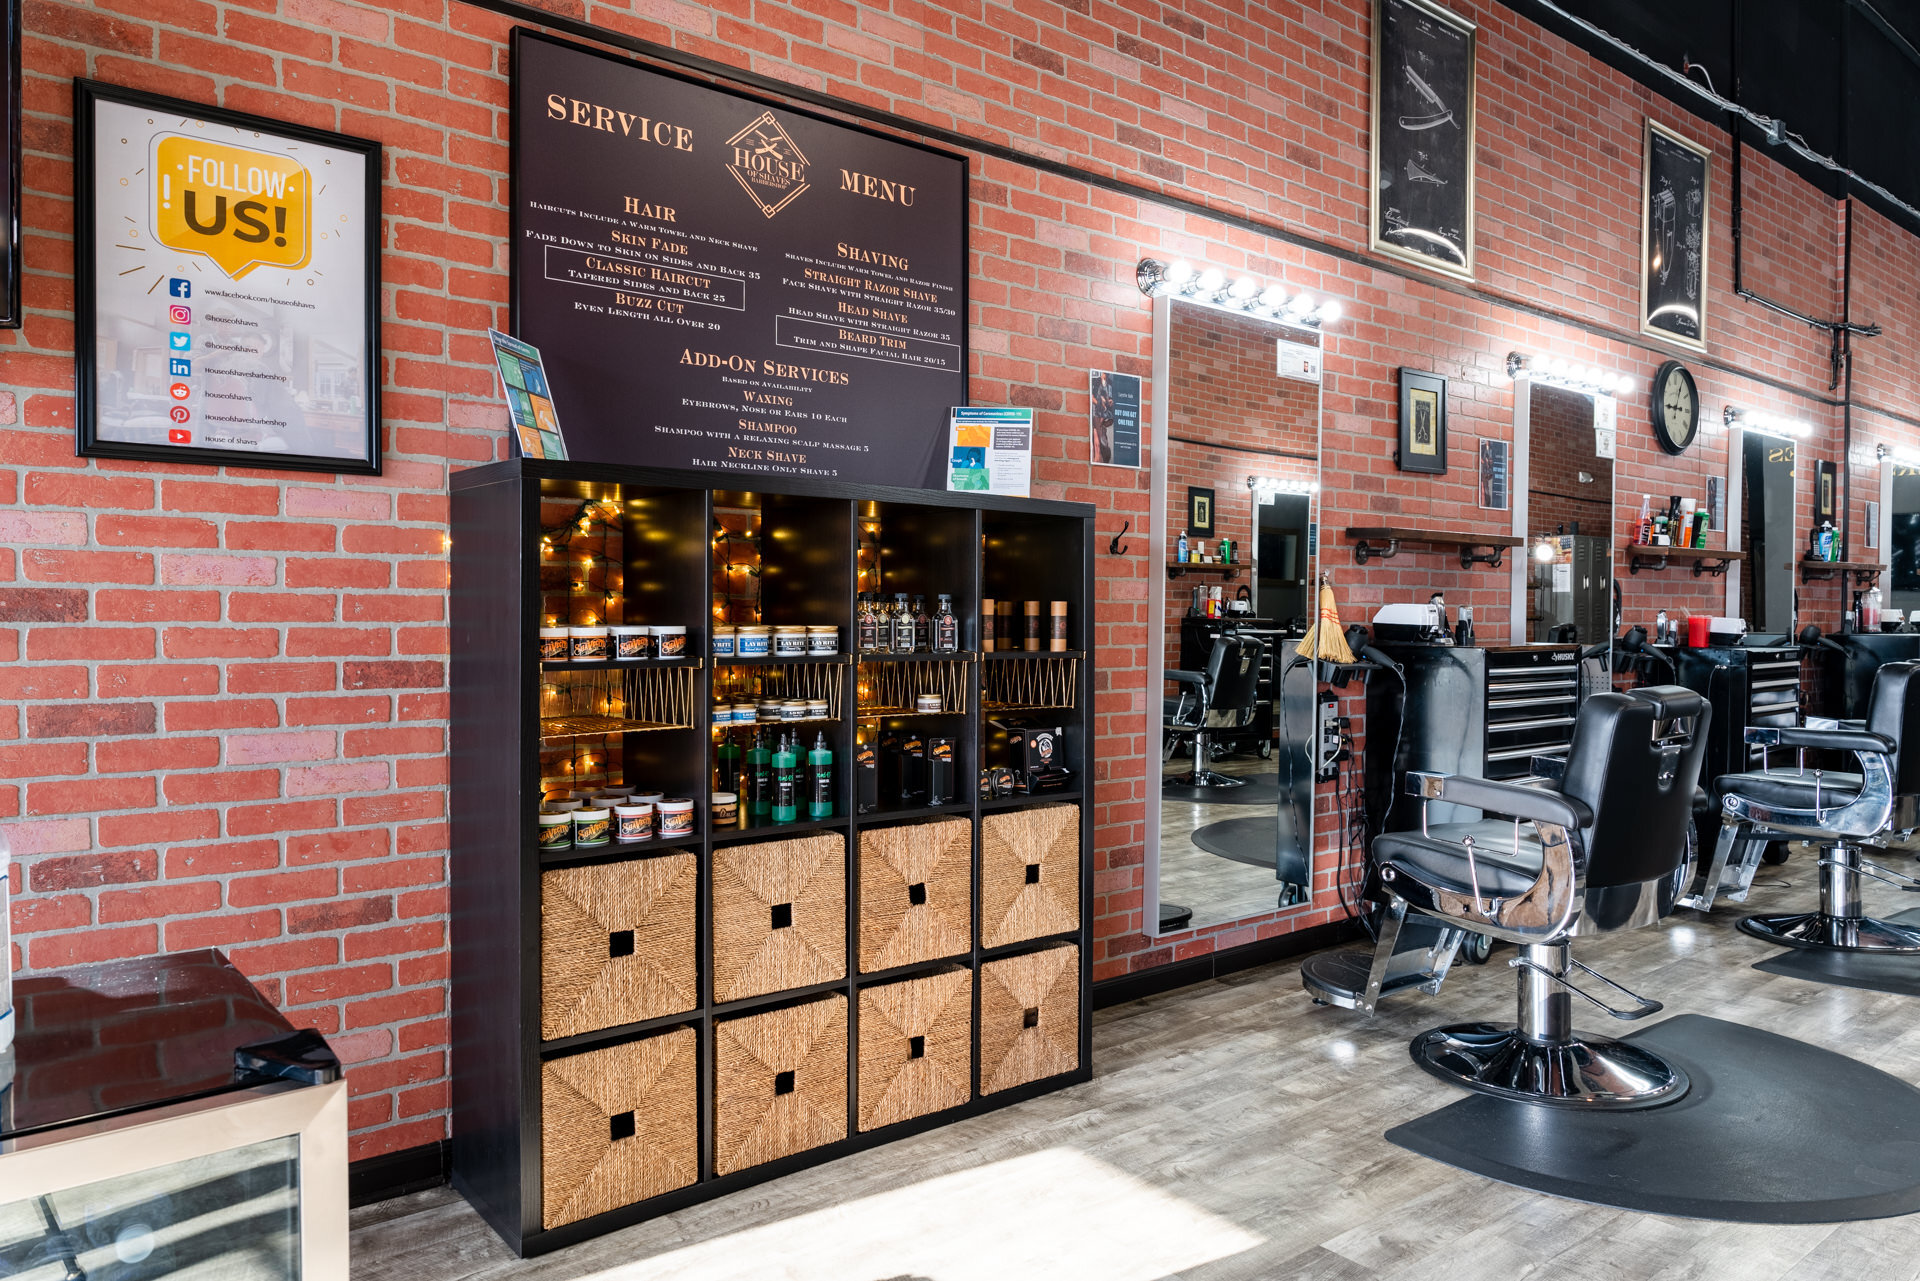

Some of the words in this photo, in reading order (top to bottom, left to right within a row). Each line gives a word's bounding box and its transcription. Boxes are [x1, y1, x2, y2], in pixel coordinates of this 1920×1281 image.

[547, 94, 694, 153] SERVICE
[840, 168, 916, 208] MENU
[188, 154, 286, 200] FOLLOW
[733, 147, 805, 182] HOUSE
[746, 170, 758, 178] OF
[760, 172, 790, 186] SHAVES
[184, 189, 288, 248] US!
[624, 196, 676, 222] HAIR
[530, 200, 576, 216] HAIRCUTS
[580, 210, 619, 224] INCLUDE
[630, 220, 656, 232] WARM
[658, 226, 688, 238] TOWEL
[690, 234, 706, 242] AND
[708, 236, 730, 246] NECK
[732, 242, 758, 252] SHAVE
[526, 230, 557, 242] FADE
[561, 236, 594, 248] DOWN
[598, 244, 612, 252] TO
[615, 247, 642, 258] SKIN
[662, 256, 693, 268] SIDES
[696, 262, 717, 272] AND
[720, 266, 746, 277] BACK
[748, 272, 760, 280] 35
[611, 230, 647, 247] SKIN
[651, 238, 688, 255] FADE
[837, 242, 909, 271] SHAVING
[586, 256, 646, 278] CLASSIC
[651, 268, 711, 289] HAIRCUT
[785, 252, 814, 263] SHAVES
[816, 258, 846, 270] INCLUDE
[848, 266, 869, 275] WARM
[870, 270, 894, 280] TOWEL
[910, 278, 930, 287] RAZOR
[932, 282, 953, 292] FINISH
[568, 269, 620, 286] TAPERED
[624, 278, 656, 291] SIDES
[658, 286, 680, 295] AND
[683, 288, 710, 300] BACK
[712, 294, 726, 302] 25
[782, 278, 806, 288] FACE
[808, 283, 837, 294] SHAVE
[840, 290, 862, 298] WITH
[864, 294, 904, 306] STRAIGHT
[906, 302, 932, 312] RAZOR
[804, 268, 860, 288] STRAIGHT
[864, 280, 900, 296] RAZOR
[904, 288, 938, 304] SHAVE
[204, 288, 316, 310] www.facebook.com/houseofshaves
[616, 292, 652, 310] BUZZ
[657, 300, 684, 314] CUT
[204, 314, 258, 328] @houseofshaves
[574, 302, 604, 313] EVEN
[608, 307, 650, 320] LENGTH
[653, 315, 674, 324] ALL
[676, 318, 704, 329] OVER
[708, 322, 720, 331] 20
[788, 306, 814, 317] HEAD
[816, 312, 844, 323] SHAVE
[848, 318, 868, 327] WITH
[871, 322, 911, 334] STRAIGHT
[913, 328, 938, 339] RAZOR
[940, 333, 950, 341] 35
[838, 302, 869, 316] HEAD
[872, 308, 908, 324] SHAVE
[204, 340, 258, 354] @houseofshaves
[794, 336, 816, 346] TRIM
[819, 340, 838, 348] AND
[840, 343, 868, 354] SHAPE
[870, 348, 900, 358] FACIAL
[902, 352, 922, 362] HAIR
[924, 356, 946, 366] 20/15
[838, 329, 876, 345] BEARD
[880, 336, 907, 350] TRIM
[680, 348, 756, 373] ADD-ON
[763, 360, 849, 386] SERVICES
[204, 390, 252, 402] houseofshaves
[722, 376, 748, 386] BASED
[762, 380, 812, 393] AVAILABILITY
[682, 398, 739, 412] EYEBROWS,
[742, 404, 767, 414] NOSE
[784, 410, 808, 418] EARS
[811, 412, 822, 420] 10
[824, 414, 848, 423] EACH
[743, 390, 793, 406] WAXING
[654, 425, 704, 437] SHAMPOO
[706, 430, 731, 440] WITH
[743, 434, 790, 444] RELAXING
[792, 440, 820, 448] SCALP
[822, 442, 862, 452] MASSAGE
[738, 418, 798, 435] SHAMPOO
[228, 436, 234, 444] of
[692, 458, 718, 468] HAIR
[720, 460, 770, 471] NECKLINE
[772, 464, 798, 474] ONLY
[800, 467, 830, 476] SHAVE
[728, 446, 762, 460] NECK
[766, 450, 806, 464] SHAVE
[1558, 652, 1575, 660] HUSKY
